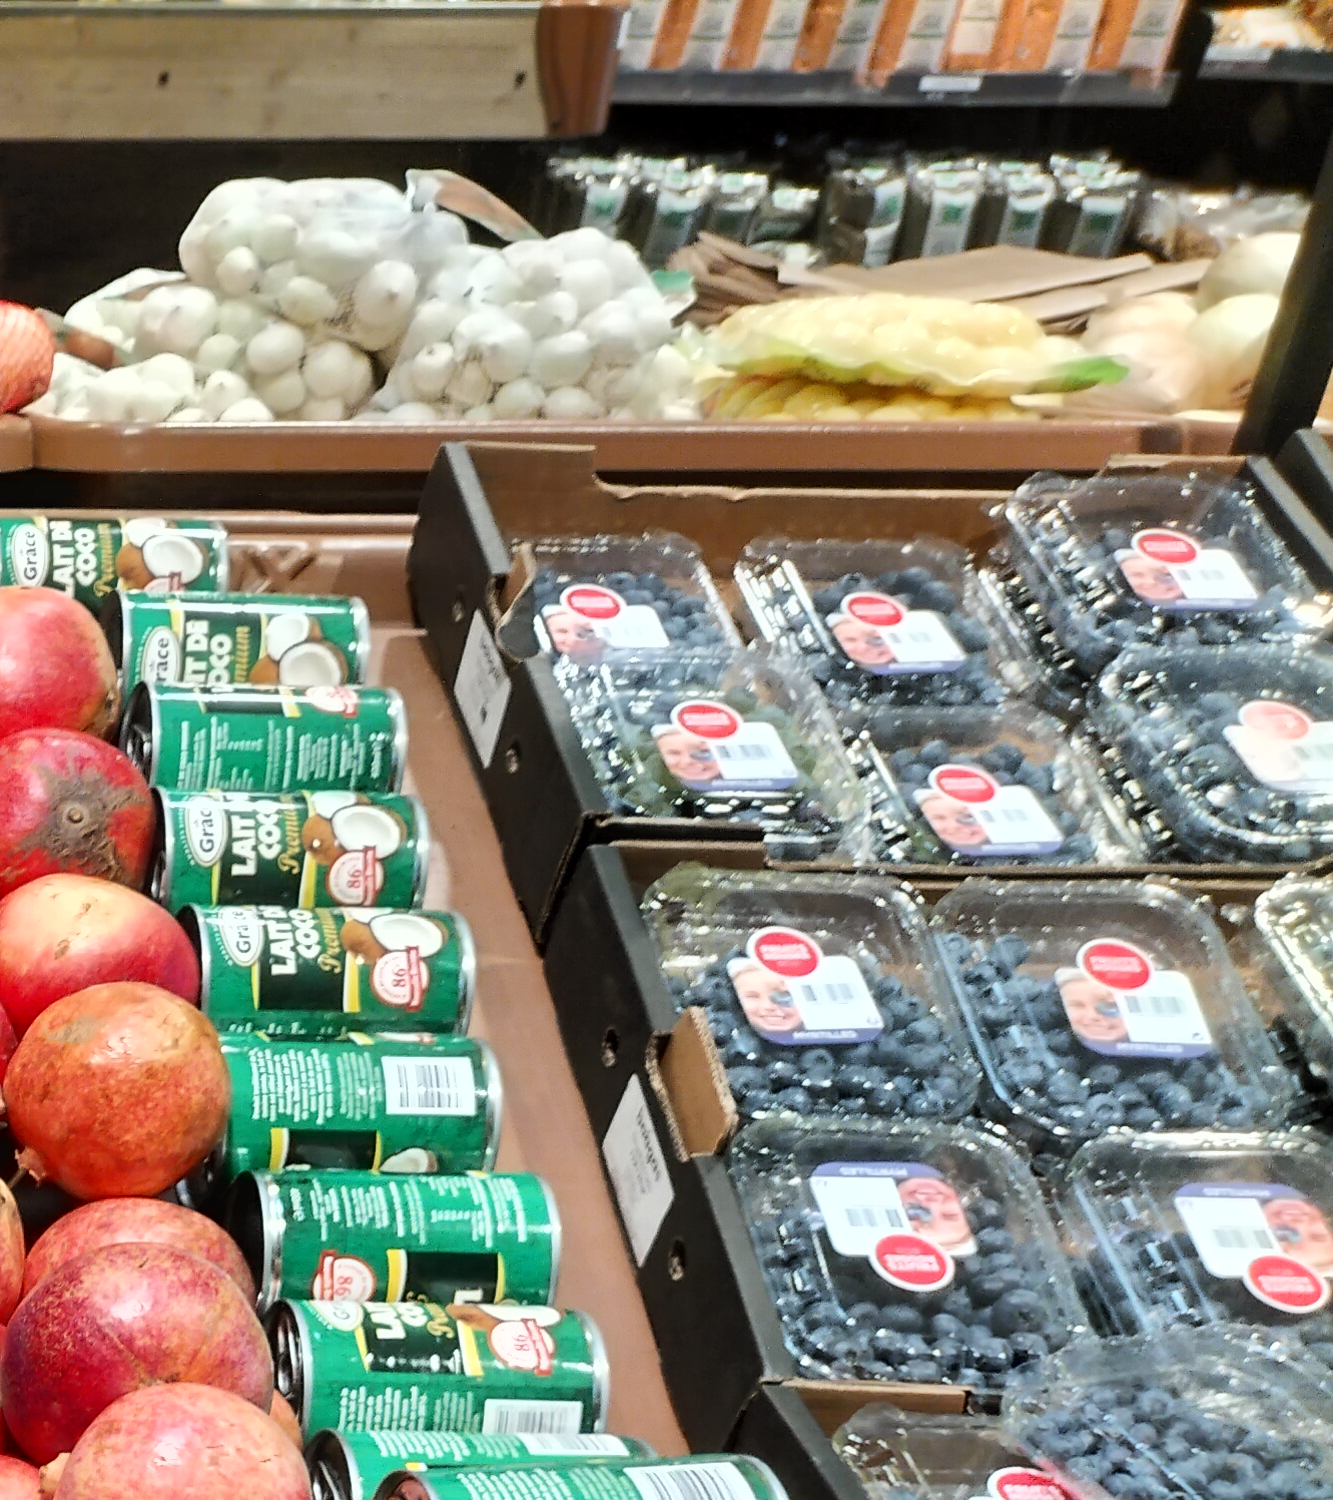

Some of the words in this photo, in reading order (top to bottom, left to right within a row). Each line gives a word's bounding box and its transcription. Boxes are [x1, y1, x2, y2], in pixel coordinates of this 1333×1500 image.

[23, 530, 38, 580] Grace
[73, 527, 97, 587] COCO
[155, 636, 170, 683] race
[186, 619, 210, 652] DE
[208, 633, 233, 685] OCO
[234, 626, 250, 683] mium
[184, 655, 209, 684] IT
[199, 809, 215, 853] Grac
[230, 814, 257, 876] LAIT
[256, 799, 282, 860] COCO
[267, 919, 297, 976] LAIT
[288, 908, 321, 959] COCO
